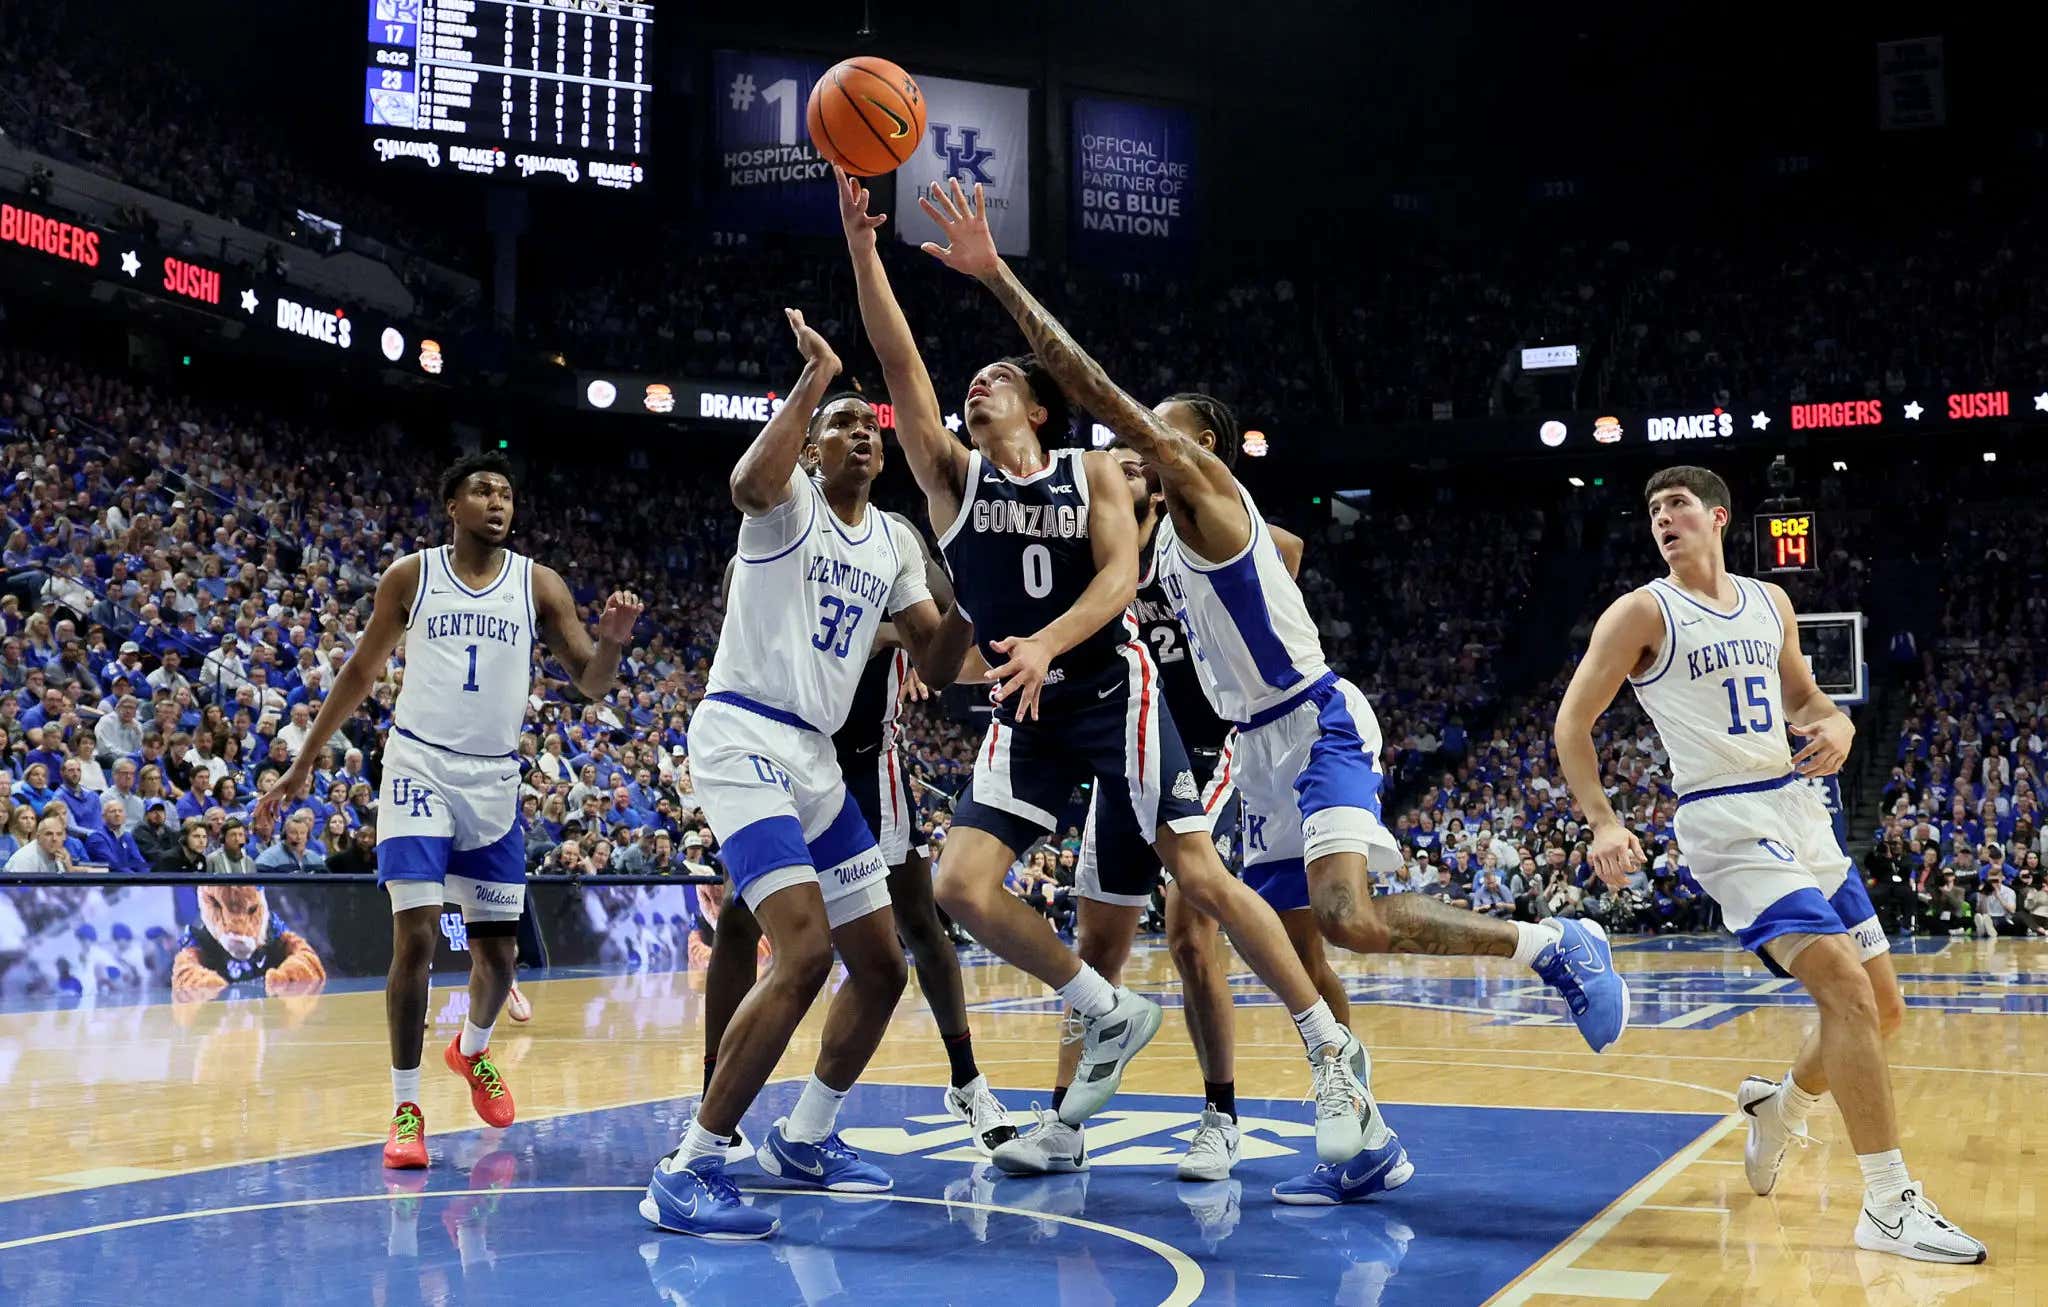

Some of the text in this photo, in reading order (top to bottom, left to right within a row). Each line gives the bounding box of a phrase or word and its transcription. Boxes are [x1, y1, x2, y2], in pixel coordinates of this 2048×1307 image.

[385, 24, 404, 43] 17
[532, 22, 540, 33] 1
[376, 49, 409, 65] 8:02
[532, 35, 540, 46] 1
[610, 45, 617, 56] 1
[531, 60, 539, 71] 1
[381, 69, 402, 90] 23
[557, 82, 564, 93] 1
[420, 91, 432, 103] 11
[583, 111, 590, 122] 1
[634, 117, 641, 128] 1
[729, 74, 798, 145] #1
[502, 127, 510, 138] 1
[529, 130, 537, 141] 1
[555, 133, 563, 144] 1
[607, 139, 615, 150] 1
[633, 142, 641, 153] 1
[530, 117, 537, 128] 1
[556, 120, 563, 131] 1
[634, 129, 641, 140] 1
[724, 146, 812, 167] HOSPITAL
[929, 121, 997, 187] UK
[1082, 134, 1157, 157] OFFICIAL
[450, 146, 506, 167] DRAKE'S
[589, 161, 643, 182] DRAKE'S
[731, 162, 829, 186] KENTUCKY
[1082, 152, 1188, 178] HEALTHCARE
[1082, 170, 1184, 195] PARTNER OF
[1082, 188, 1181, 216] BIG BLUE
[1083, 210, 1169, 237] NATION
[0, 204, 352, 348] BURGERS SUSHI DRAKE'S
[1647, 391, 2009, 442] DRAKE'S BURGERS SUSHI
[1048, 484, 1073, 495] WCC
[973, 499, 1089, 539] GONZAGA
[1770, 517, 1809, 537] 8:02
[1777, 537, 1806, 565] 14
[807, 555, 889, 609] KENTUCKY
[1022, 544, 1053, 599] 0
[427, 613, 520, 647] KENTUCKY
[812, 595, 863, 659] 33
[463, 644, 479, 692] 1
[1721, 676, 1773, 735] 15
[393, 778, 433, 818] UK
[834, 857, 884, 885] Wildcats
[474, 884, 519, 905] Wildcats
